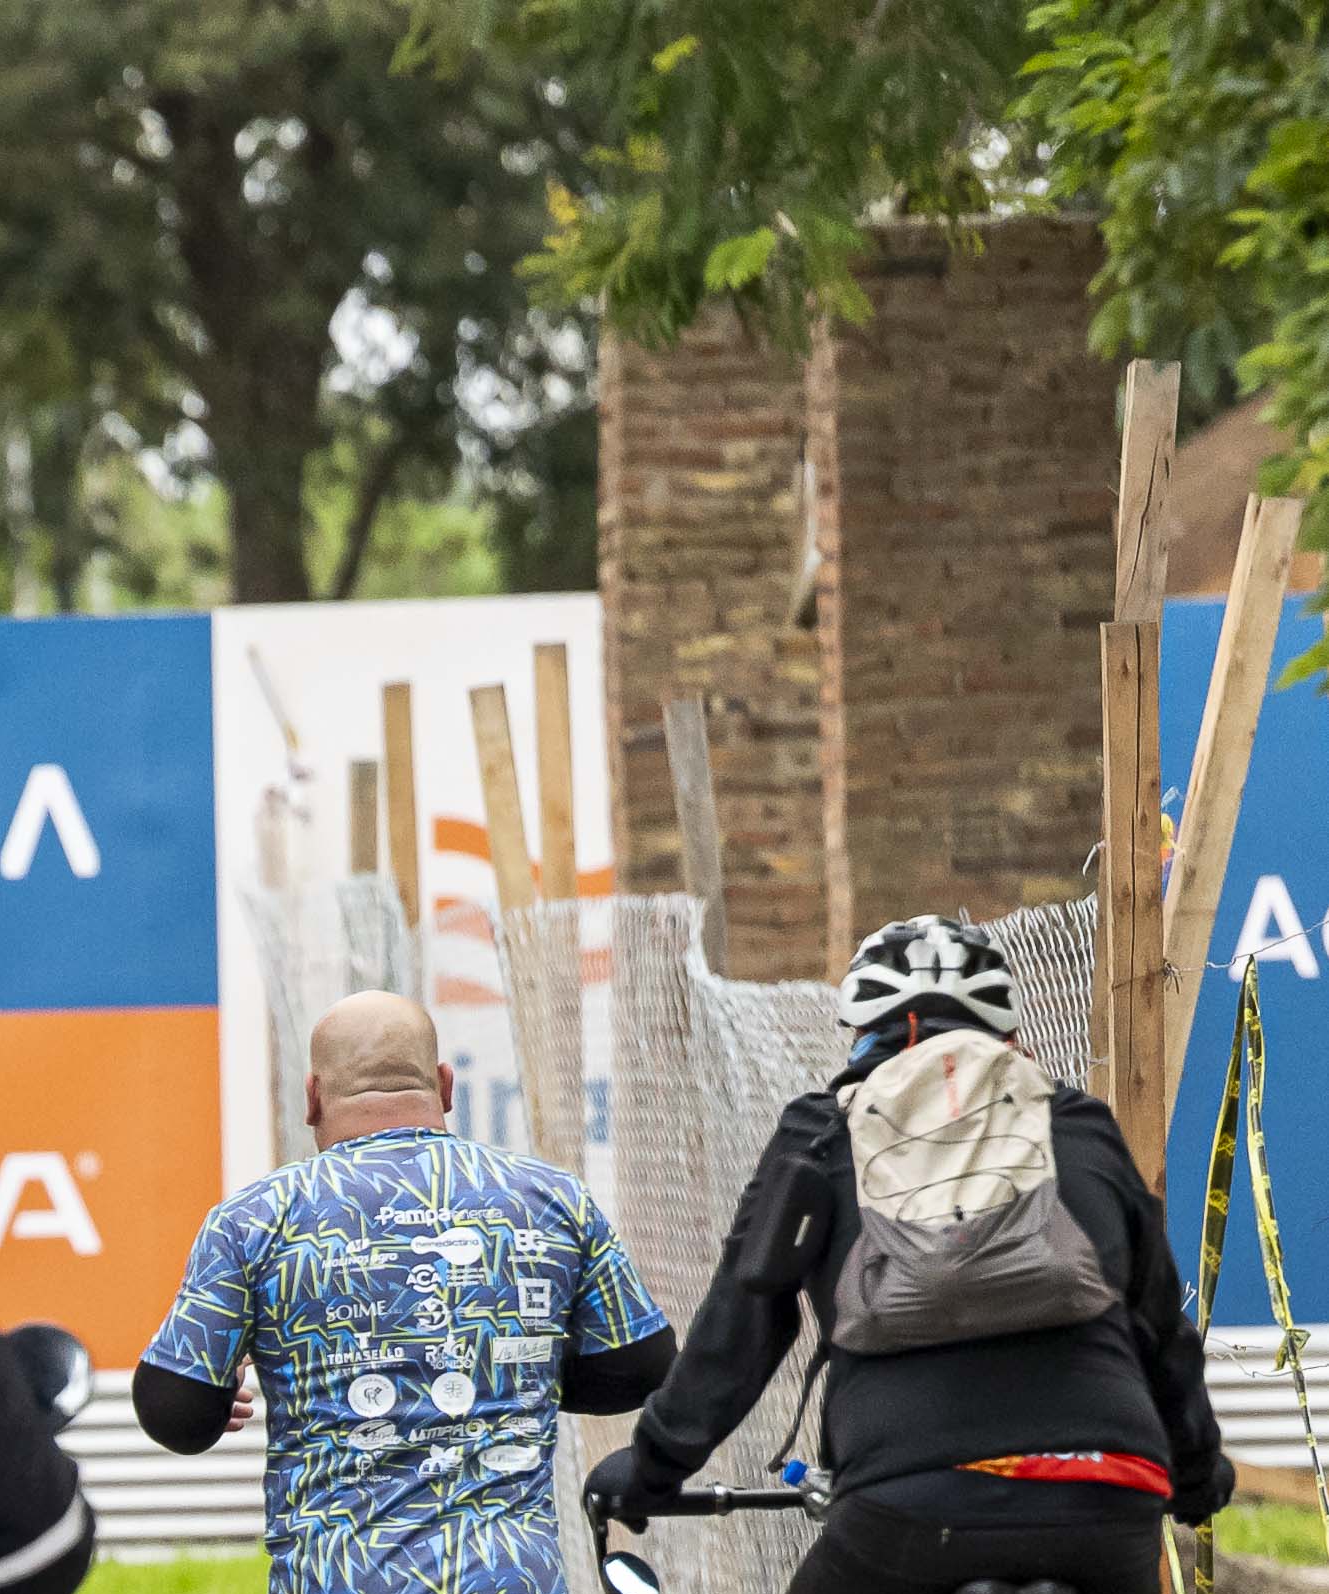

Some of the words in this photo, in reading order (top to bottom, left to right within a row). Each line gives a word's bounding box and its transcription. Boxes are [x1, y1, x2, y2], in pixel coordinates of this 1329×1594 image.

[1227, 874, 1329, 984] A
[375, 1206, 451, 1226] Pampa
[325, 1299, 388, 1322] SOIME
[327, 1347, 404, 1364] TOMASELLO
